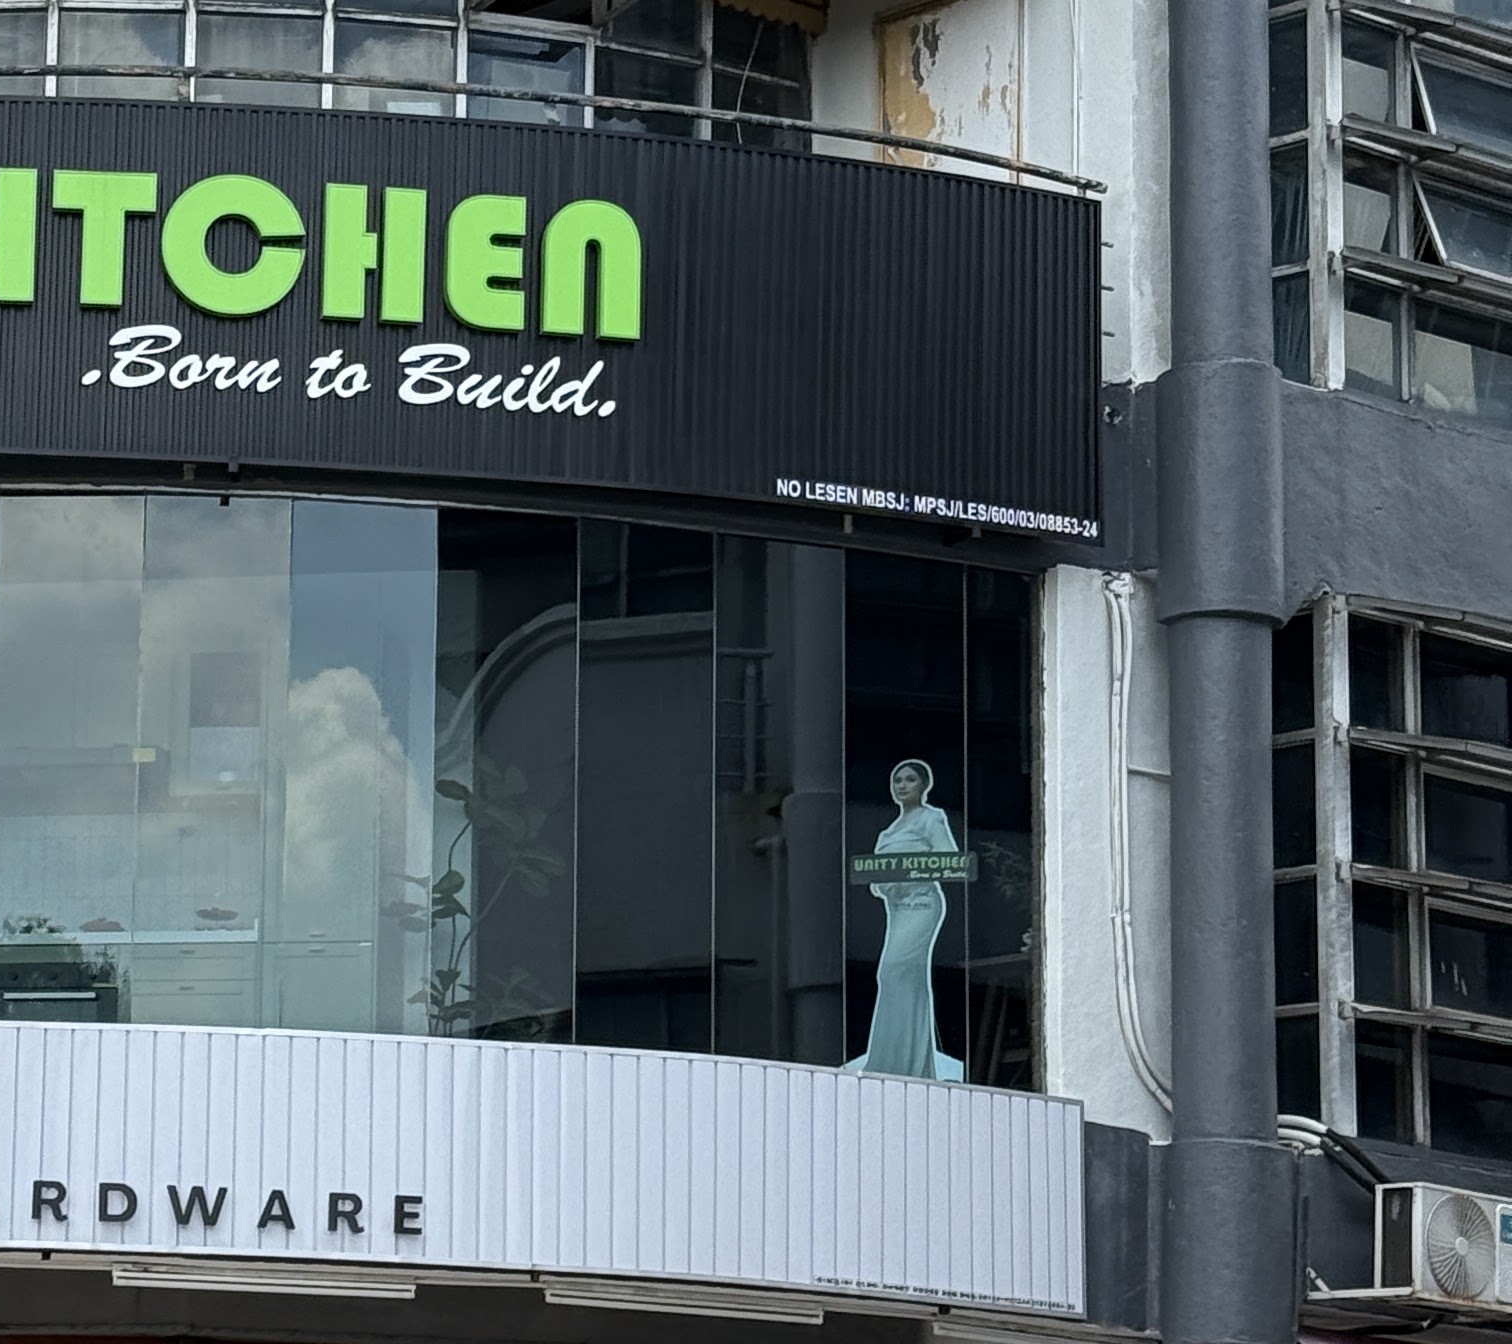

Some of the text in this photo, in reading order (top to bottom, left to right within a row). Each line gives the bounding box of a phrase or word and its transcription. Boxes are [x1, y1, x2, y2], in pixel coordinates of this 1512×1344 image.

[305, 348, 372, 400] to
[776, 479, 801, 497] NO
[805, 481, 858, 505] LESEN
[862, 488, 910, 512] MBSJ:
[854, 857, 898, 871] UNITY
